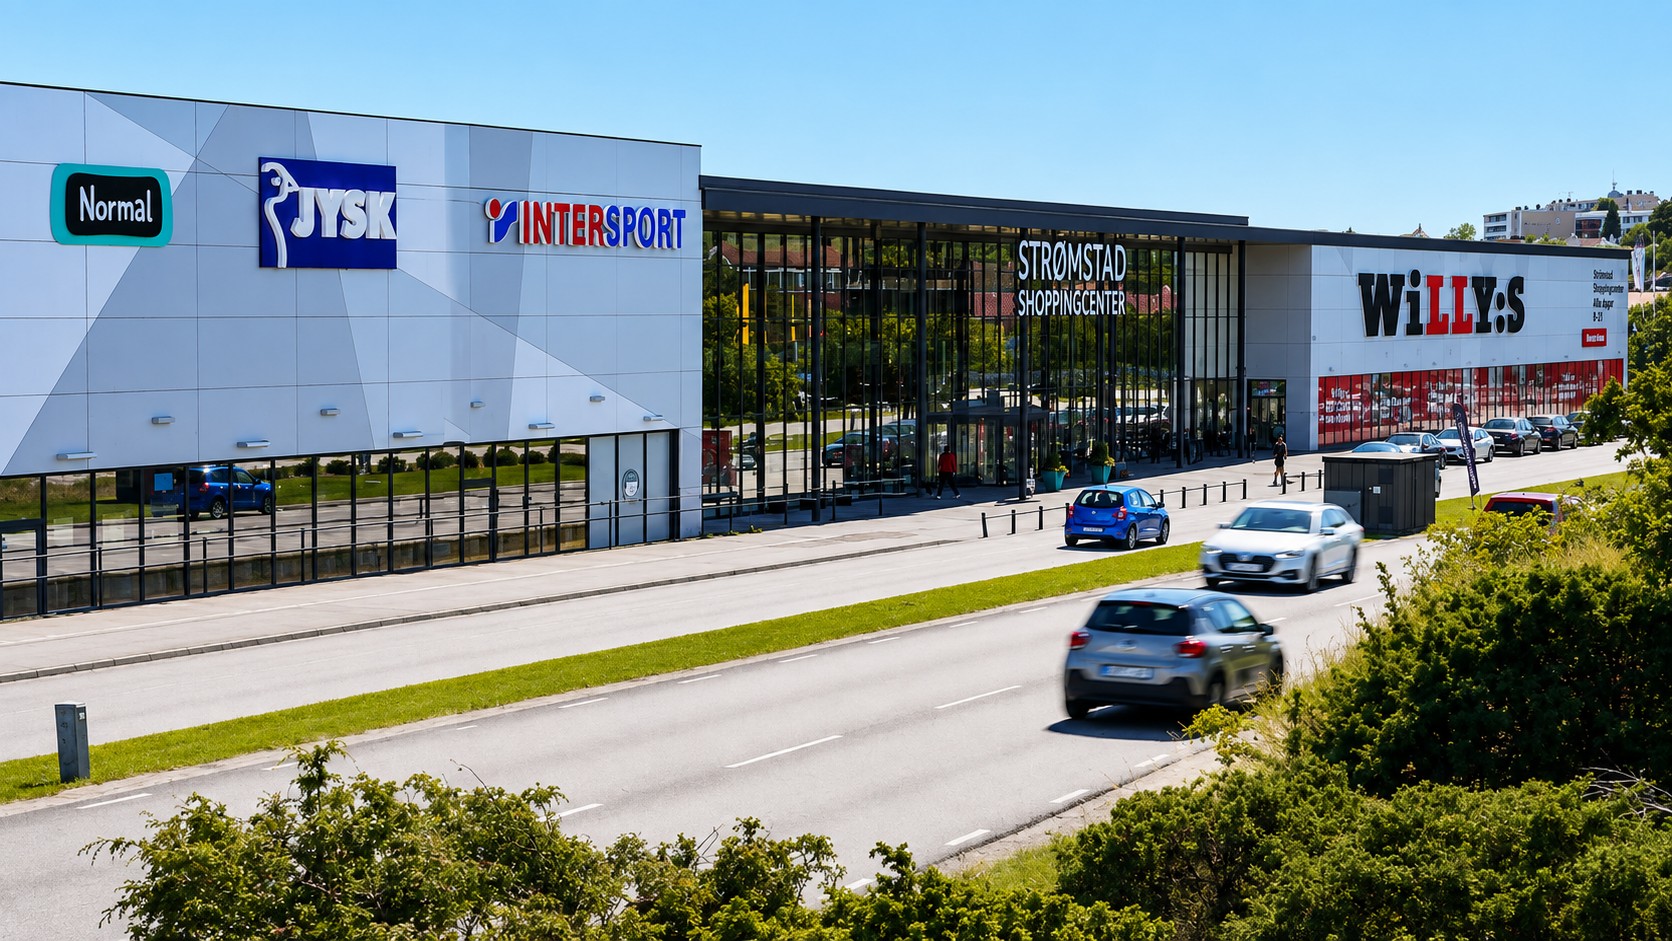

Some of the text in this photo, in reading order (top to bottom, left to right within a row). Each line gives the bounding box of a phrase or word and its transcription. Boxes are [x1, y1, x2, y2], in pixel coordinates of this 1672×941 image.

[80, 184, 153, 224] Normal
[292, 187, 397, 240] JYSK
[518, 201, 686, 250] INTERSPORT
[1018, 239, 1127, 282] STRØMSTAD
[1018, 289, 1126, 316] SHOPPINGCENTER
